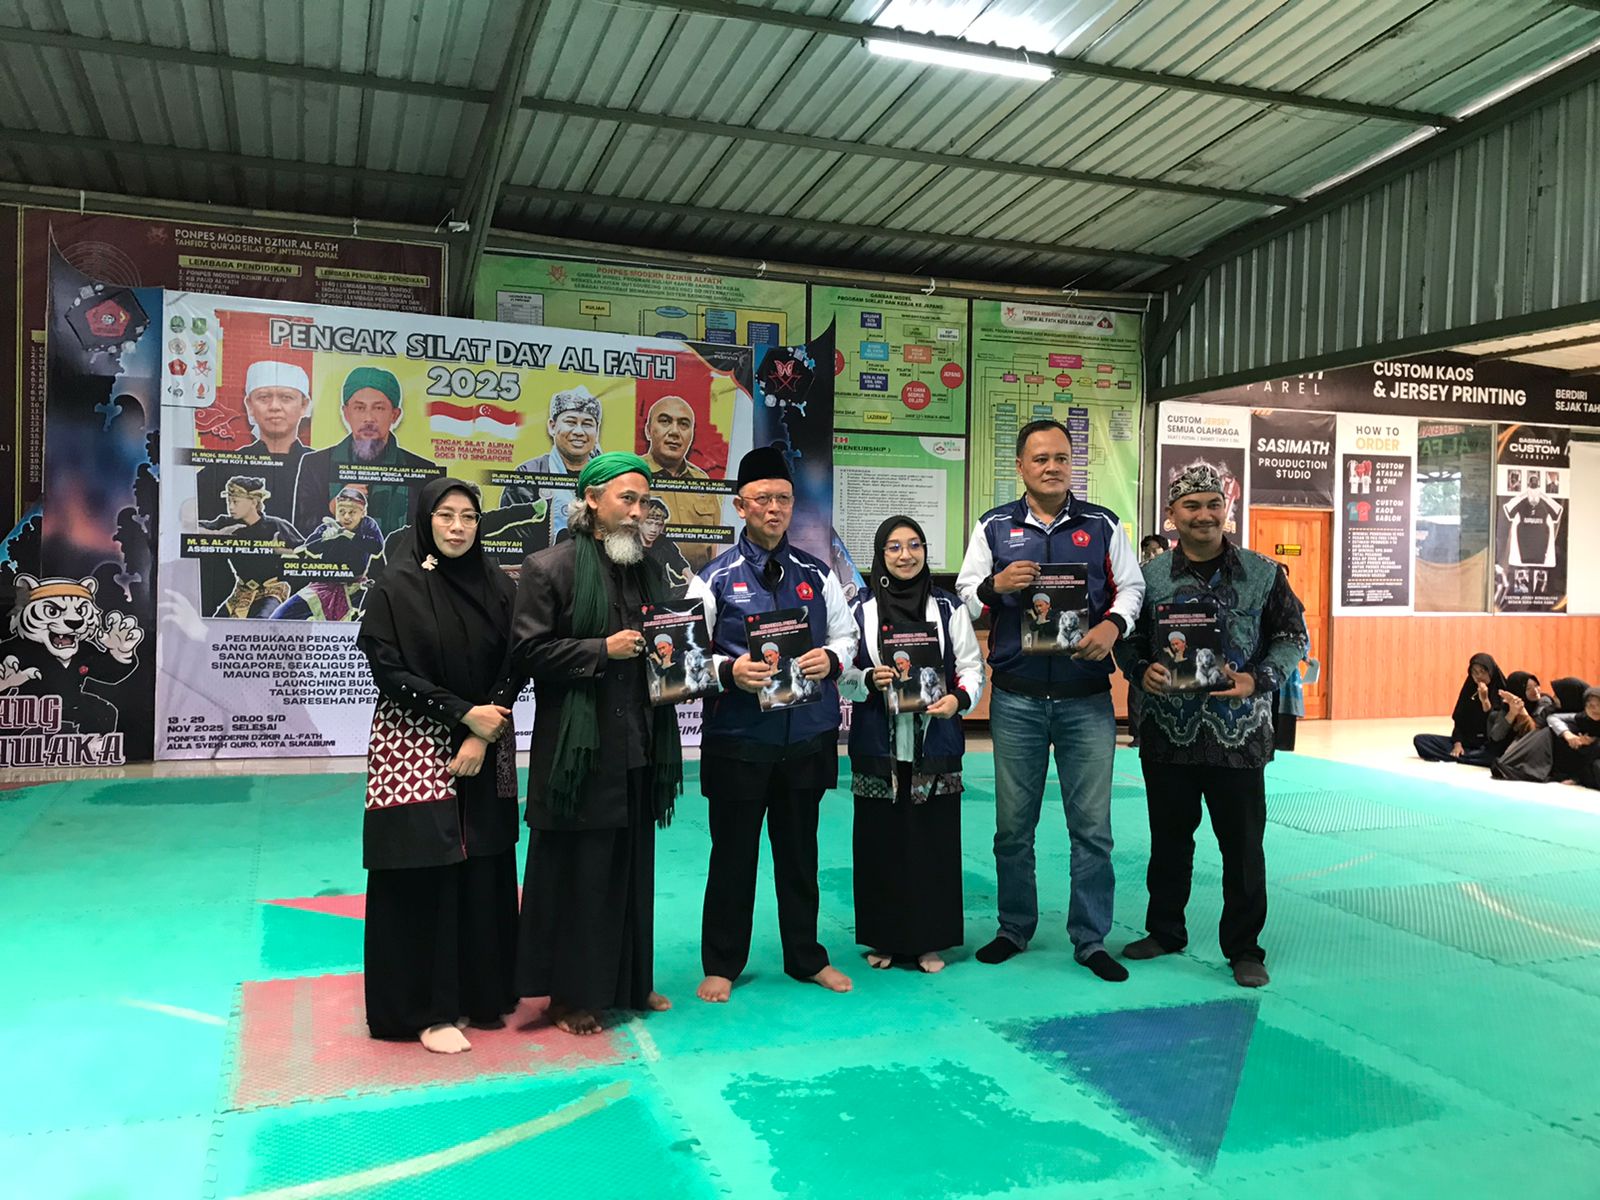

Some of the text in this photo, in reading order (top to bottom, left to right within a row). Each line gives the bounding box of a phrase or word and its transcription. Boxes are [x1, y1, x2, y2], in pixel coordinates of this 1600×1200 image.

[175, 229, 338, 251] PONPES MODERN DZIKIR AL FATH
[175, 239, 208, 248] TAHFIDZ
[242, 245, 264, 253] SILAT
[278, 248, 339, 260] INTERNASIONAL
[188, 258, 292, 274] LEMBAGA PENDIDIKAN
[270, 318, 676, 381] PENCAK SILAT DAY AL FATH
[1373, 361, 1474, 382] CUSTOM KAOS
[426, 365, 522, 402] 2025
[1373, 380, 1527, 406] & JERSEY PRINTING
[1555, 389, 1588, 400] BERDIRI
[1555, 401, 1600, 414] SEJAK TAH
[1167, 414, 1231, 426] CUSTOM JERSEY
[1167, 424, 1240, 436] SEMUA OLAHRAGA
[1356, 426, 1400, 436] HOW TO
[430, 438, 514, 450] PENCAK SILAT ALIRAN
[1257, 438, 1330, 456] SASIMATH
[1356, 438, 1400, 450] ORDER
[1509, 444, 1560, 454] CUSTOM
[470, 454, 513, 463] SINGAPORE
[1258, 458, 1328, 470] PROUDUCTION
[1276, 468, 1311, 480] STUDIO
[211, 539, 252, 547] AL-FATH
[186, 546, 274, 554] ASSISTEN PELATIH
[302, 563, 338, 571] CANDRA
[283, 570, 354, 578] PELATIH UTAMA
[225, 635, 356, 643] PEMBUKAAN PENCAK
[212, 644, 248, 652] SANG
[250, 644, 297, 652] MAUNG
[298, 644, 340, 652] BODAS
[218, 652, 254, 661] SANG
[256, 653, 303, 661] MAUNG
[304, 653, 346, 661] BODAS
[211, 662, 354, 671] SINGAPORE, SEKALIGUS
[223, 670, 270, 678] MAUNG
[272, 671, 318, 679] BODAS,
[275, 680, 346, 688] LAUNCHING
[268, 688, 380, 696] TALKSHOW PENCA
[283, 697, 356, 705] SARESEHAN
[232, 714, 286, 723] 08.00 S/D
[167, 724, 224, 733] NOV 2025
[232, 724, 277, 732] SELESAI
[166, 734, 206, 742] PONPES
[208, 734, 250, 742] MODERN
[166, 740, 336, 750] AULA SYEKH QURO, KOTA SUKABUMI
[0, 733, 126, 768] WAKA
